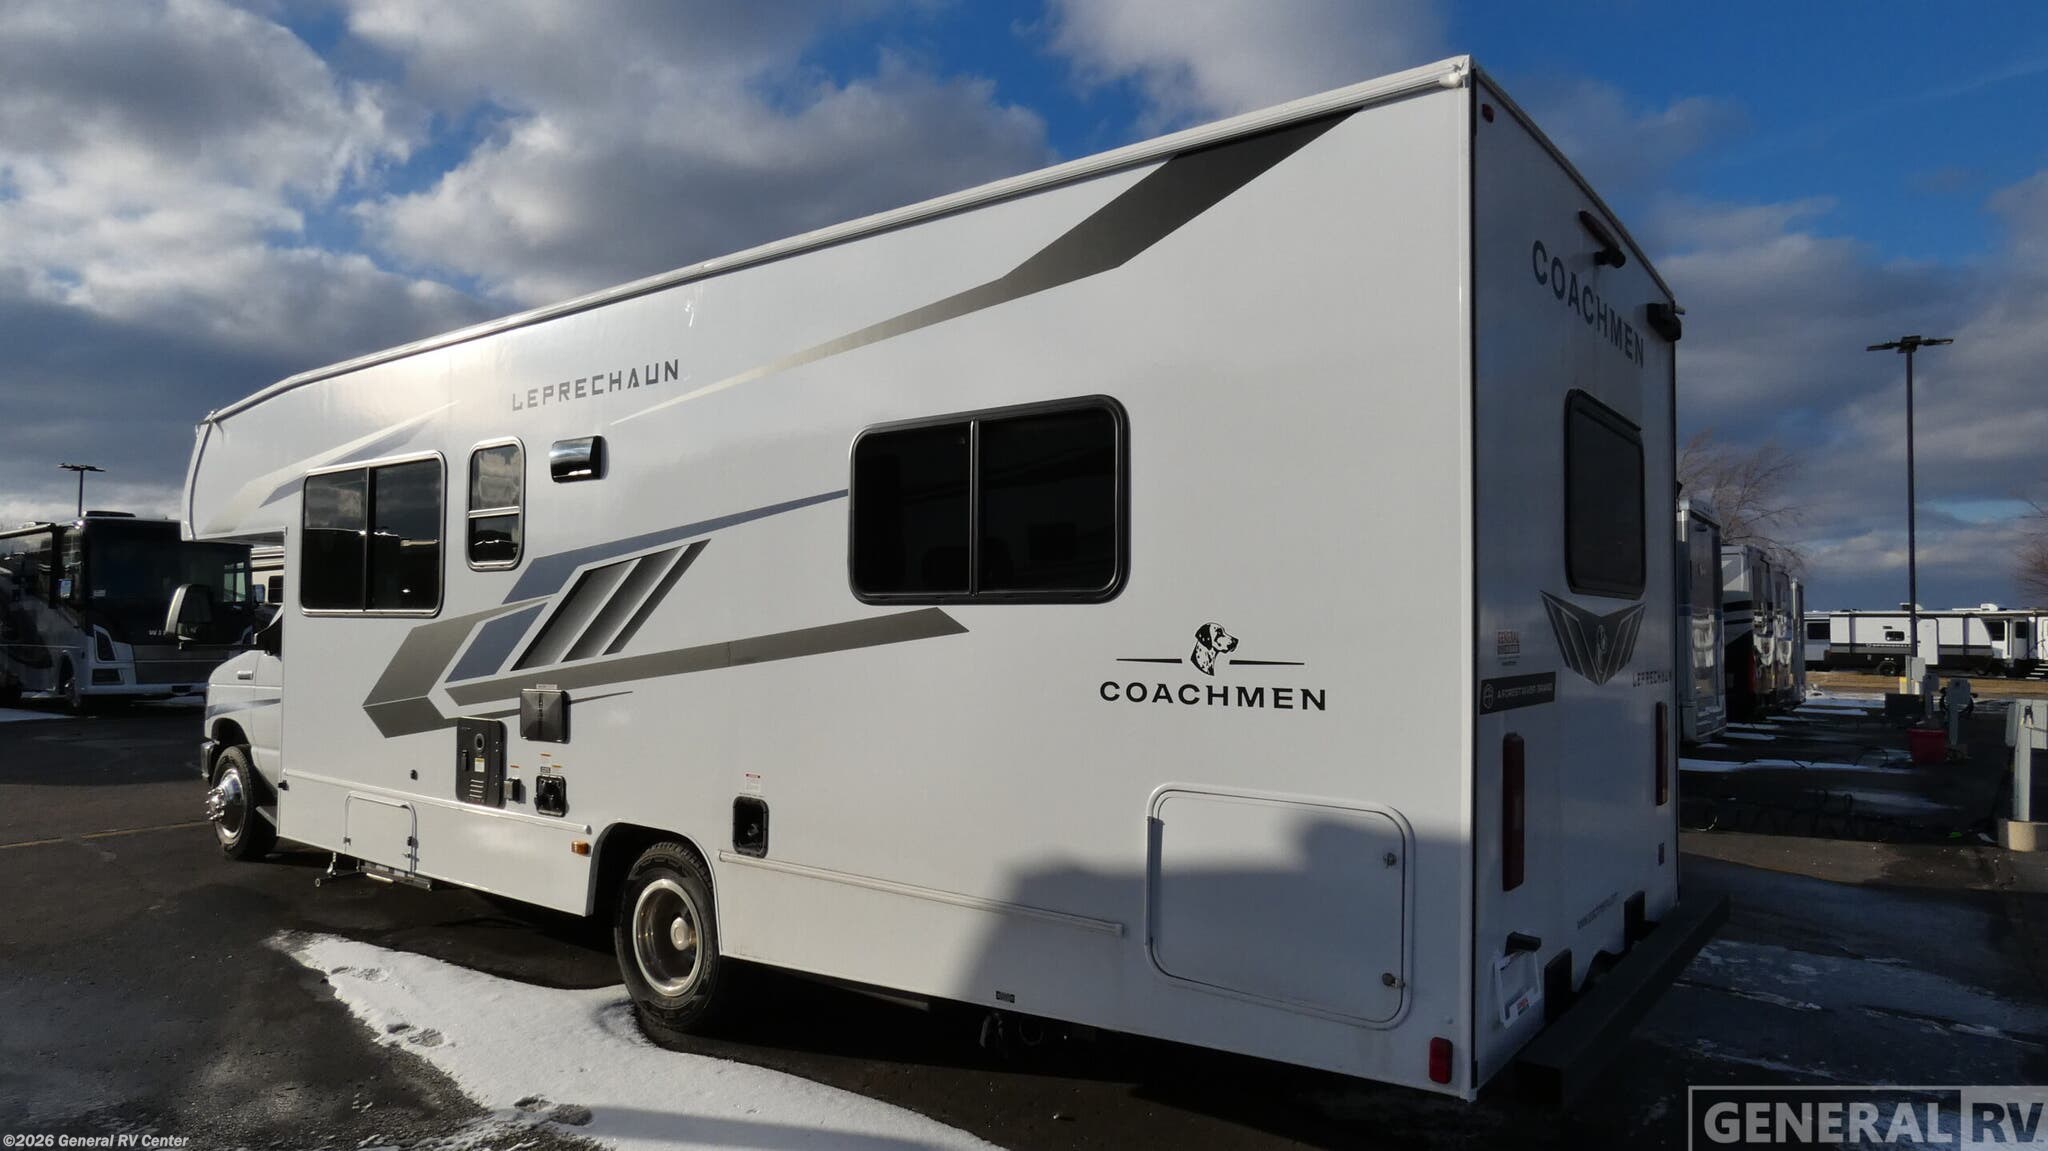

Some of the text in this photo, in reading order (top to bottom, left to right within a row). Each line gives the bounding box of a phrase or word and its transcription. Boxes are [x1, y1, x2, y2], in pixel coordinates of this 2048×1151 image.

[1532, 240, 1644, 369] COACHMEN
[512, 359, 679, 412] LEPRECHAUN
[1099, 680, 1326, 711] COACHMEN
